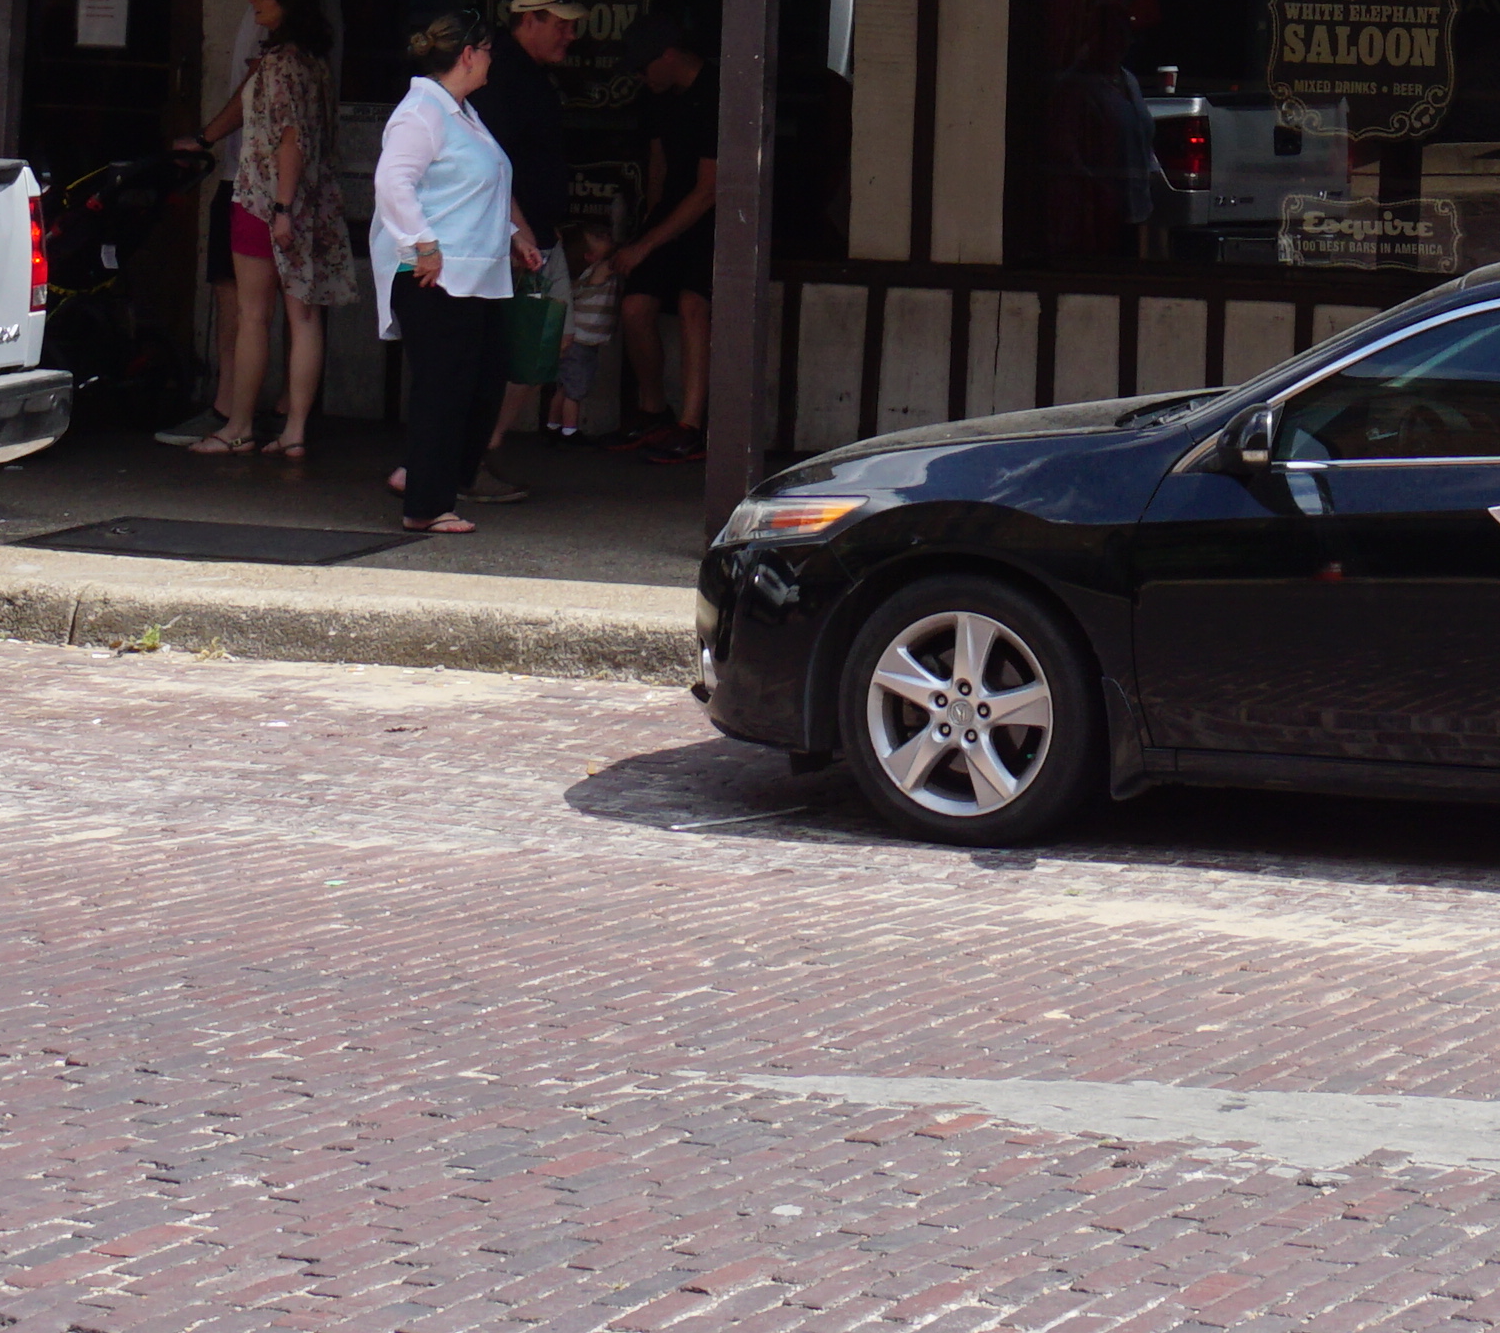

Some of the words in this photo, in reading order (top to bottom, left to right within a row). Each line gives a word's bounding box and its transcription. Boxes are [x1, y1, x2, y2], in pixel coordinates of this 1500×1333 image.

[1283, 2, 1344, 21] WHITE
[1349, 4, 1441, 24] ELEPHANT
[1283, 23, 1440, 67] SALOON
[1294, 79, 1331, 93] MIXED
[1335, 80, 1378, 95] DRINKS
[1393, 82, 1423, 97] BEER
[1302, 210, 1434, 241] Esquire
[1297, 240, 1316, 251] 100
[1319, 240, 1346, 252] BEST
[1349, 241, 1377, 254] BARS
[1380, 242, 1391, 254] IN
[1395, 243, 1443, 255] AMERICA
